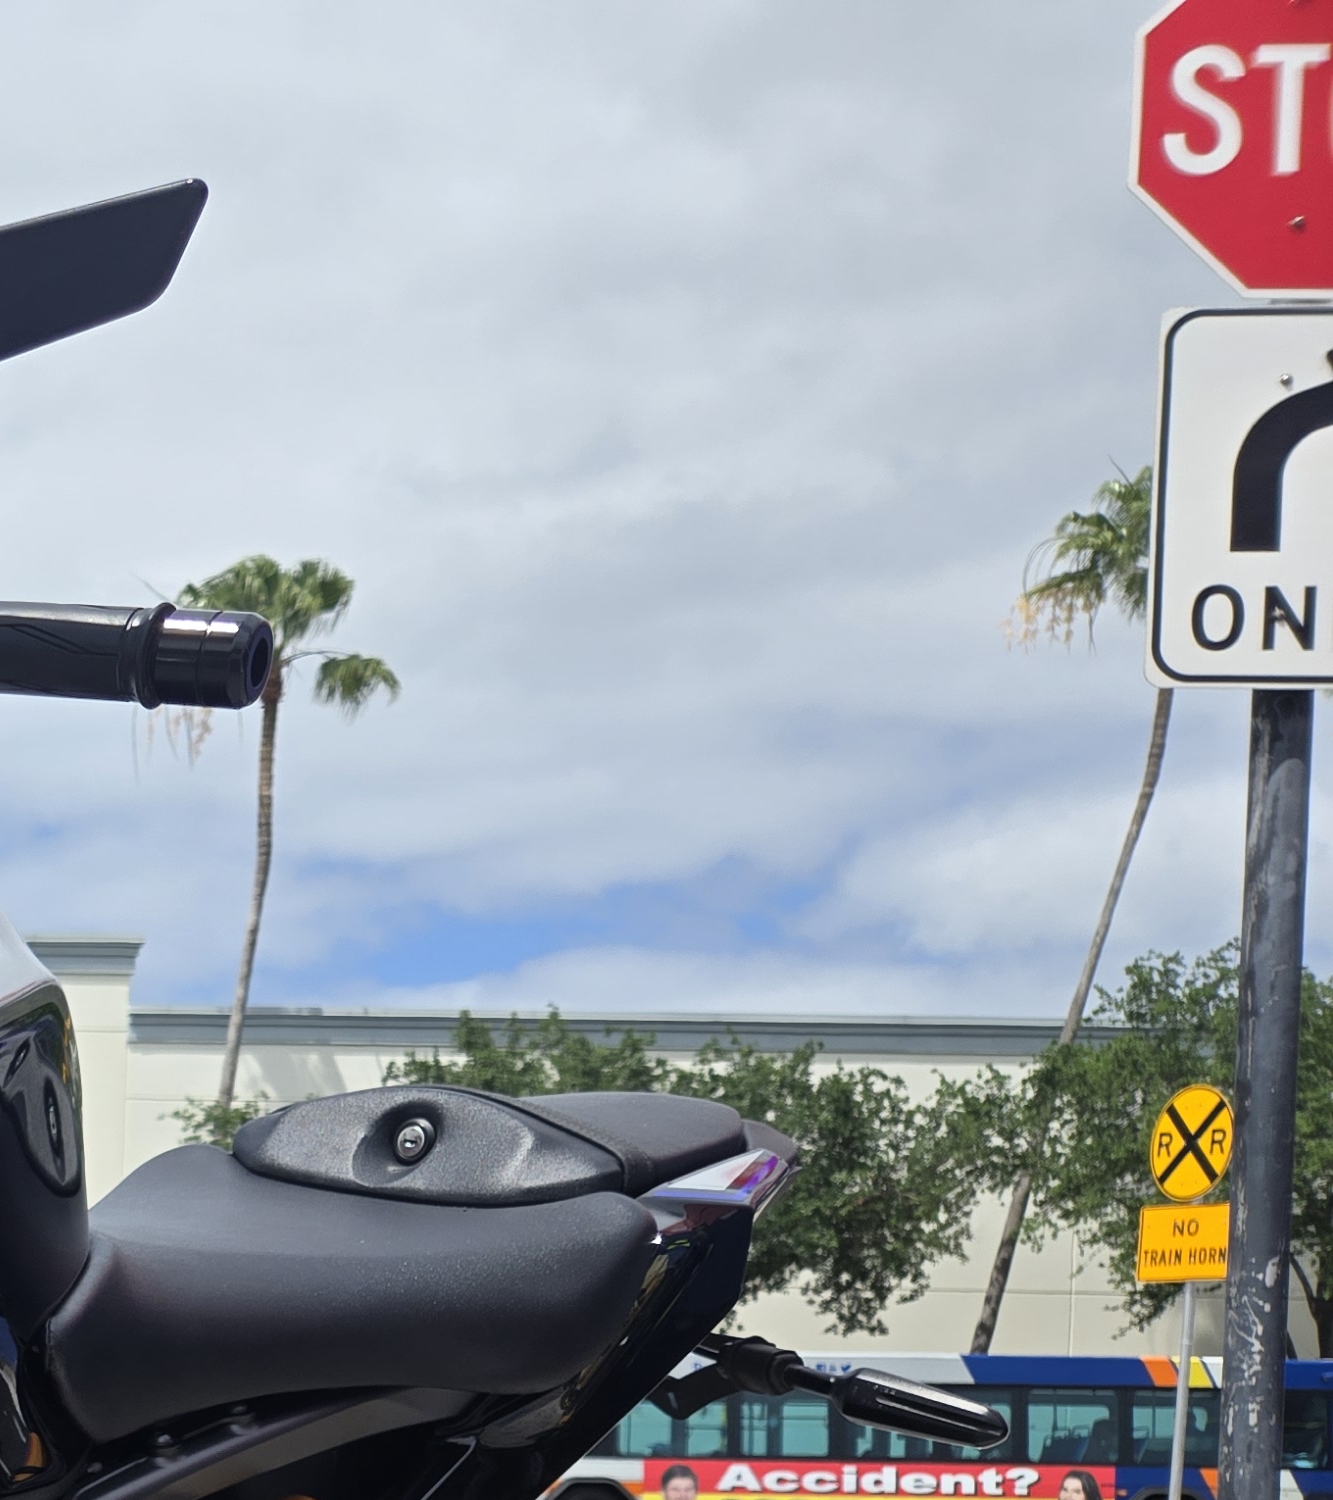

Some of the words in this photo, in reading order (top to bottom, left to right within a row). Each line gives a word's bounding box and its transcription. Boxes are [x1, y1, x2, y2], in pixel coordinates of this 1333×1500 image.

[1162, 43, 1333, 177] ST
[1173, 1218, 1199, 1238] NO
[1143, 1249, 1182, 1268] TRAIN
[1188, 1246, 1226, 1265] HORN
[716, 1463, 1039, 1495] Accident?
